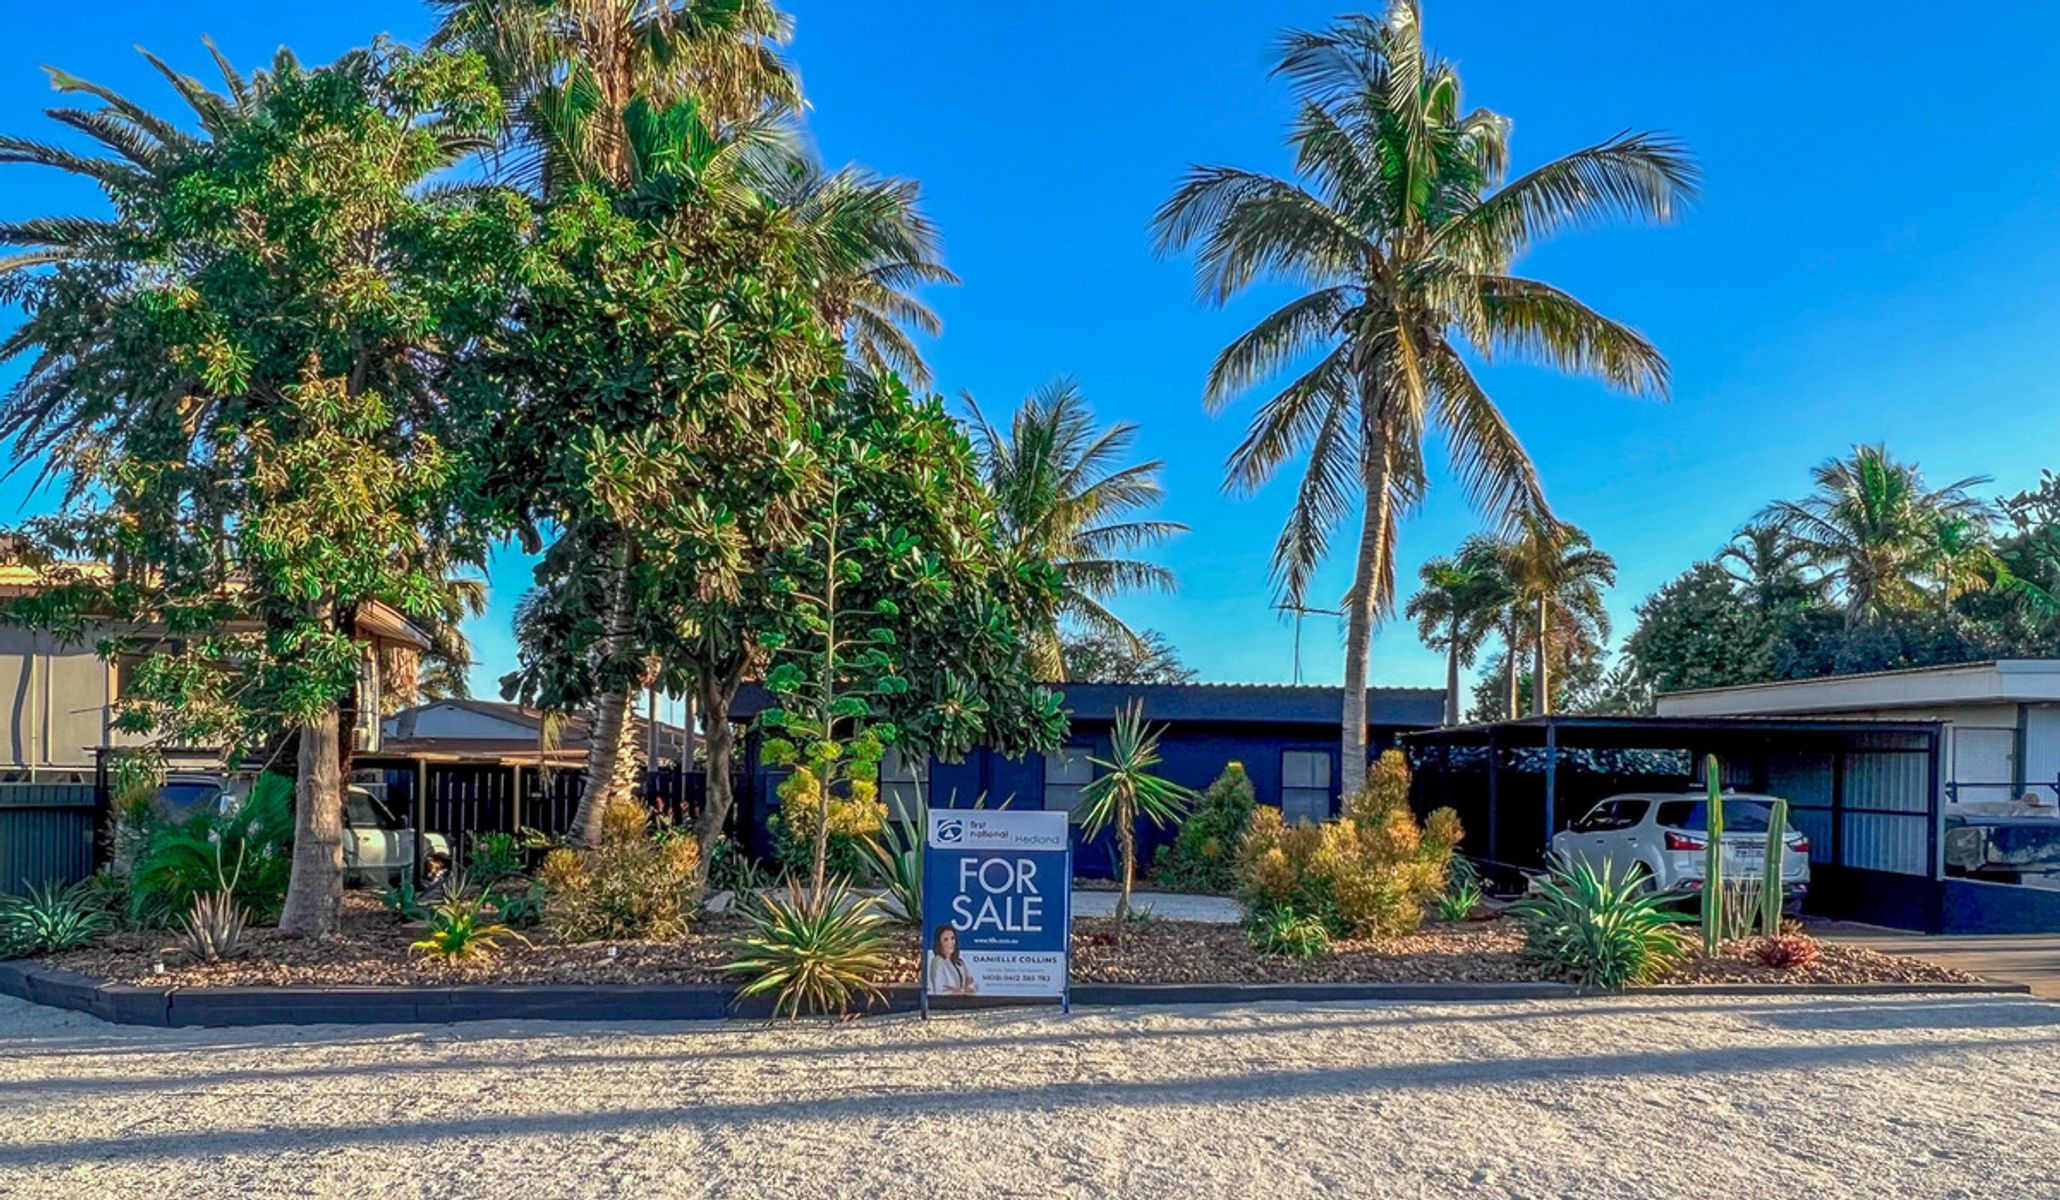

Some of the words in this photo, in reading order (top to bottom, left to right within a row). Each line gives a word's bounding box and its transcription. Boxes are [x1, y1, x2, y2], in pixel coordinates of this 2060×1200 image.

[970, 820, 987, 829] first
[970, 831, 1009, 839] national
[1015, 835, 1060, 844] Hedland
[960, 857, 1039, 894] FOR
[950, 894, 1043, 932] SALE
[973, 955, 1017, 963] DANIELLE
[1018, 956, 1057, 964] COLLINS
